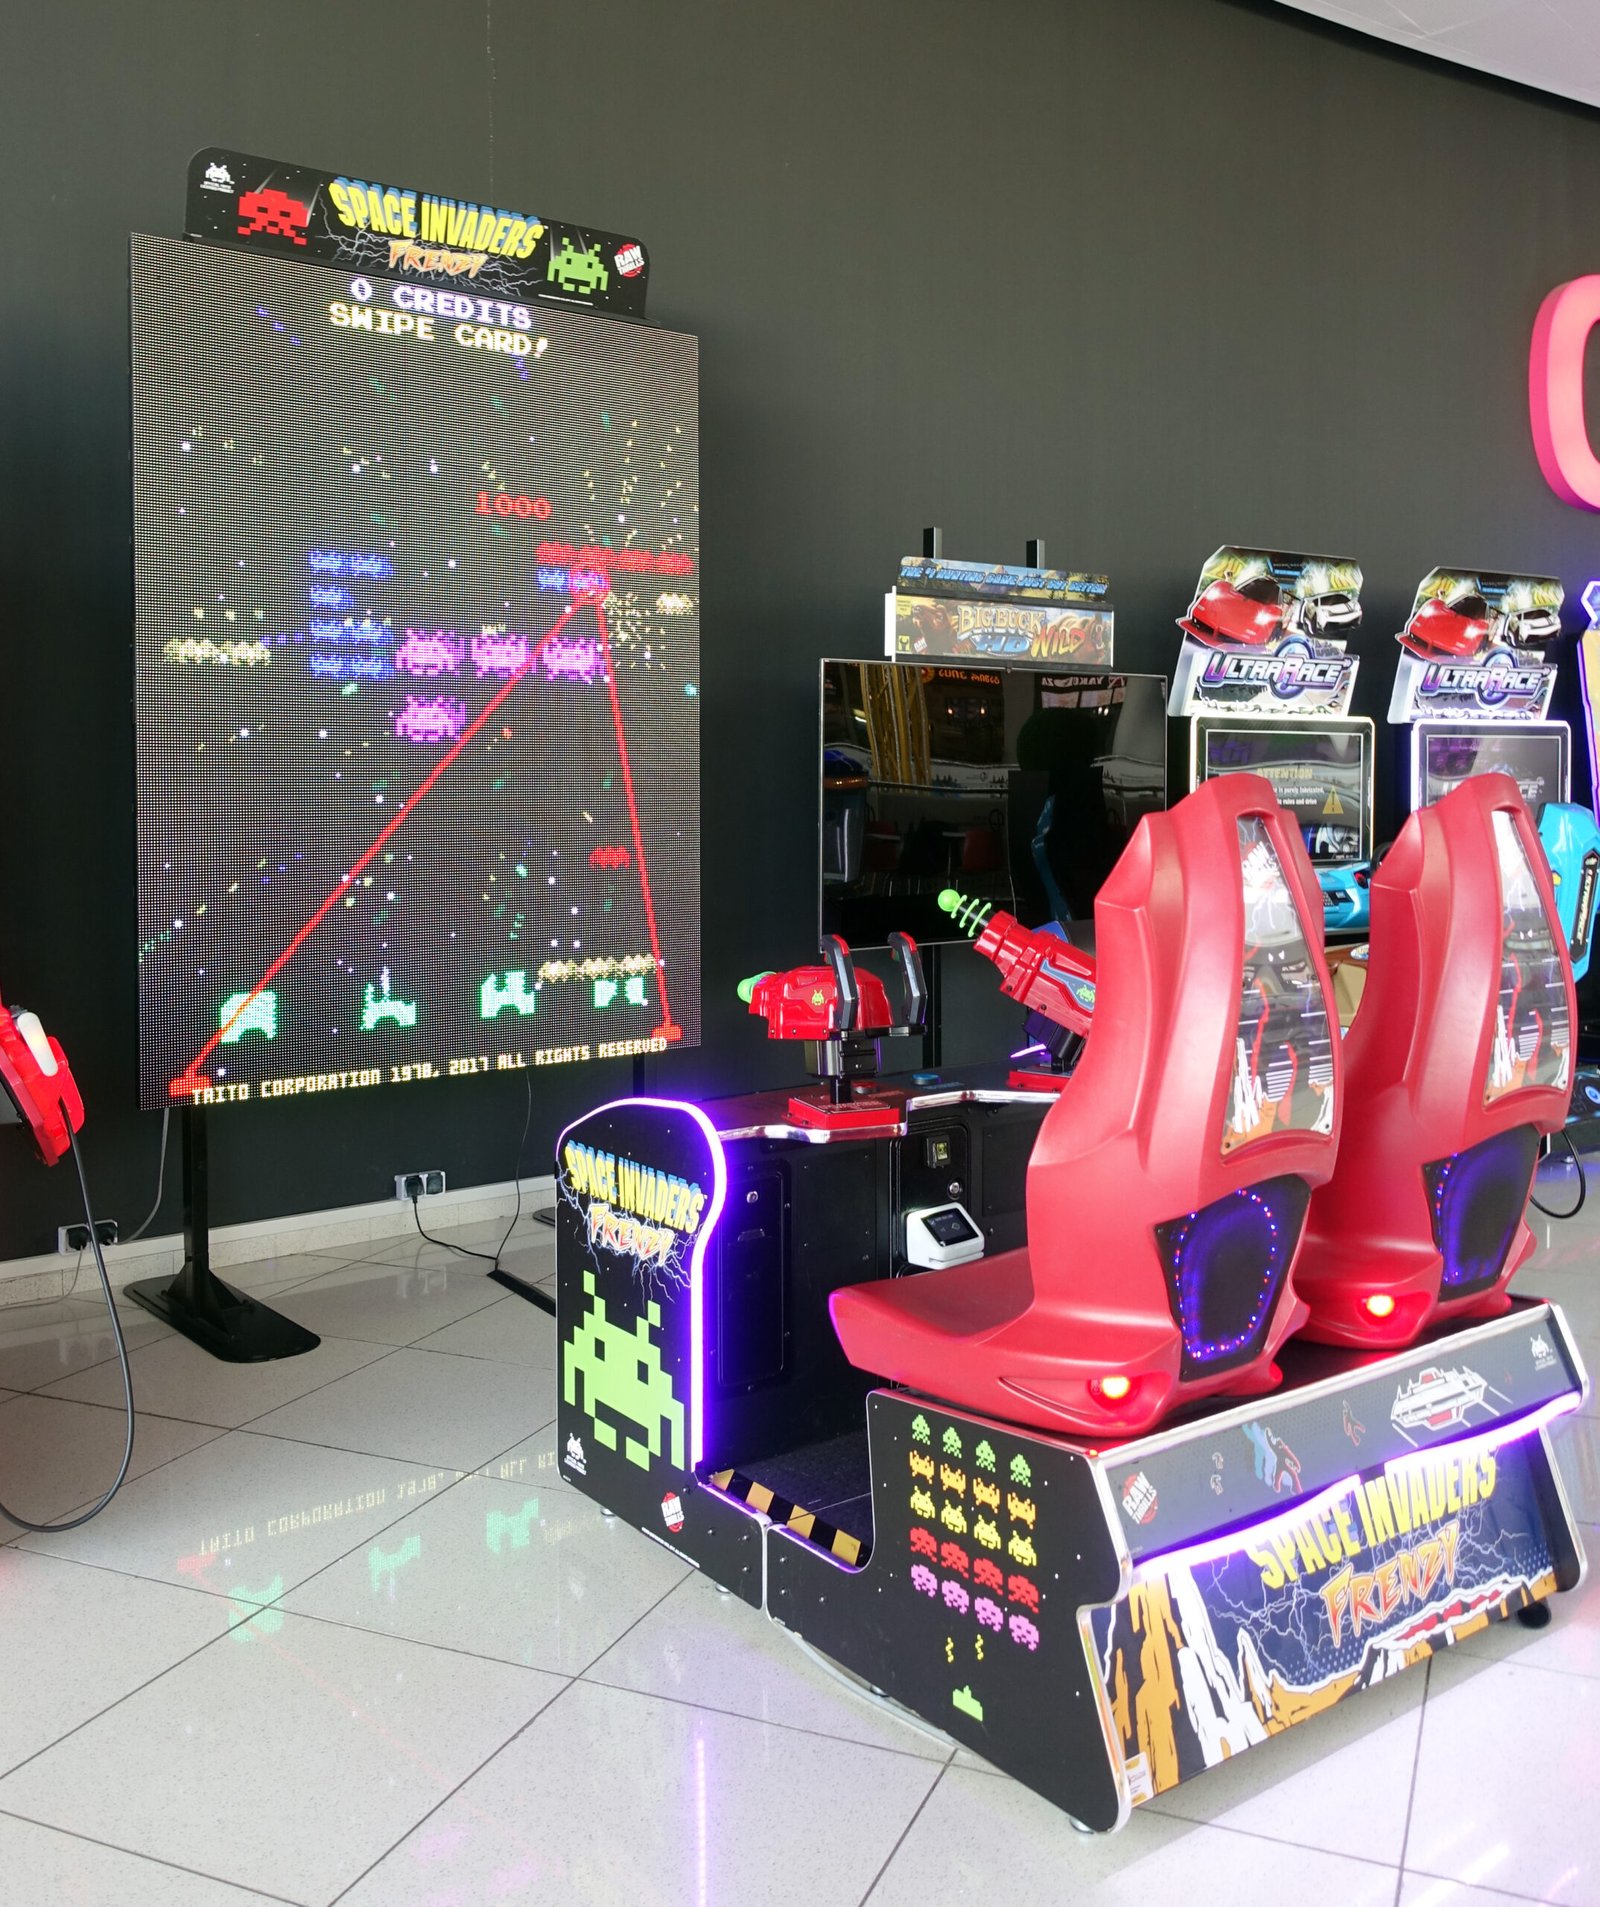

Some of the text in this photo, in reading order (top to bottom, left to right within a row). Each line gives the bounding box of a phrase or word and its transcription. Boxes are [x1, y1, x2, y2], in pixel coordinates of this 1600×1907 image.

[328, 178, 544, 259] SPACE INVADERS
[388, 239, 488, 278] FRENZY
[614, 245, 643, 269] RAW
[329, 303, 548, 357] SWIPE CARD!
[392, 286, 532, 330] CREDITS
[474, 491, 552, 520] 1000
[900, 565, 924, 578] THE
[936, 568, 985, 583] HUNTING
[985, 573, 1018, 587] GAME
[1018, 576, 1045, 590] JUST
[957, 605, 1047, 635] BIG BUCK
[1030, 622, 1086, 657] WILD
[1256, 767, 1313, 779] ATTENTION
[192, 1083, 250, 1105] TAITO
[261, 1068, 382, 1098] CORPORATION
[449, 1056, 488, 1075] 2017
[498, 1052, 527, 1070] ALL
[535, 1045, 590, 1065] RIGHTS
[599, 1037, 667, 1058] RESERVED
[565, 1140, 704, 1234] SPACE INVADERS
[588, 1203, 675, 1266] FRENZY
[1122, 1471, 1151, 1517] RAW
[1248, 1451, 1497, 1589] SPACE INVADERS
[1320, 1519, 1459, 1648] FRENZY
